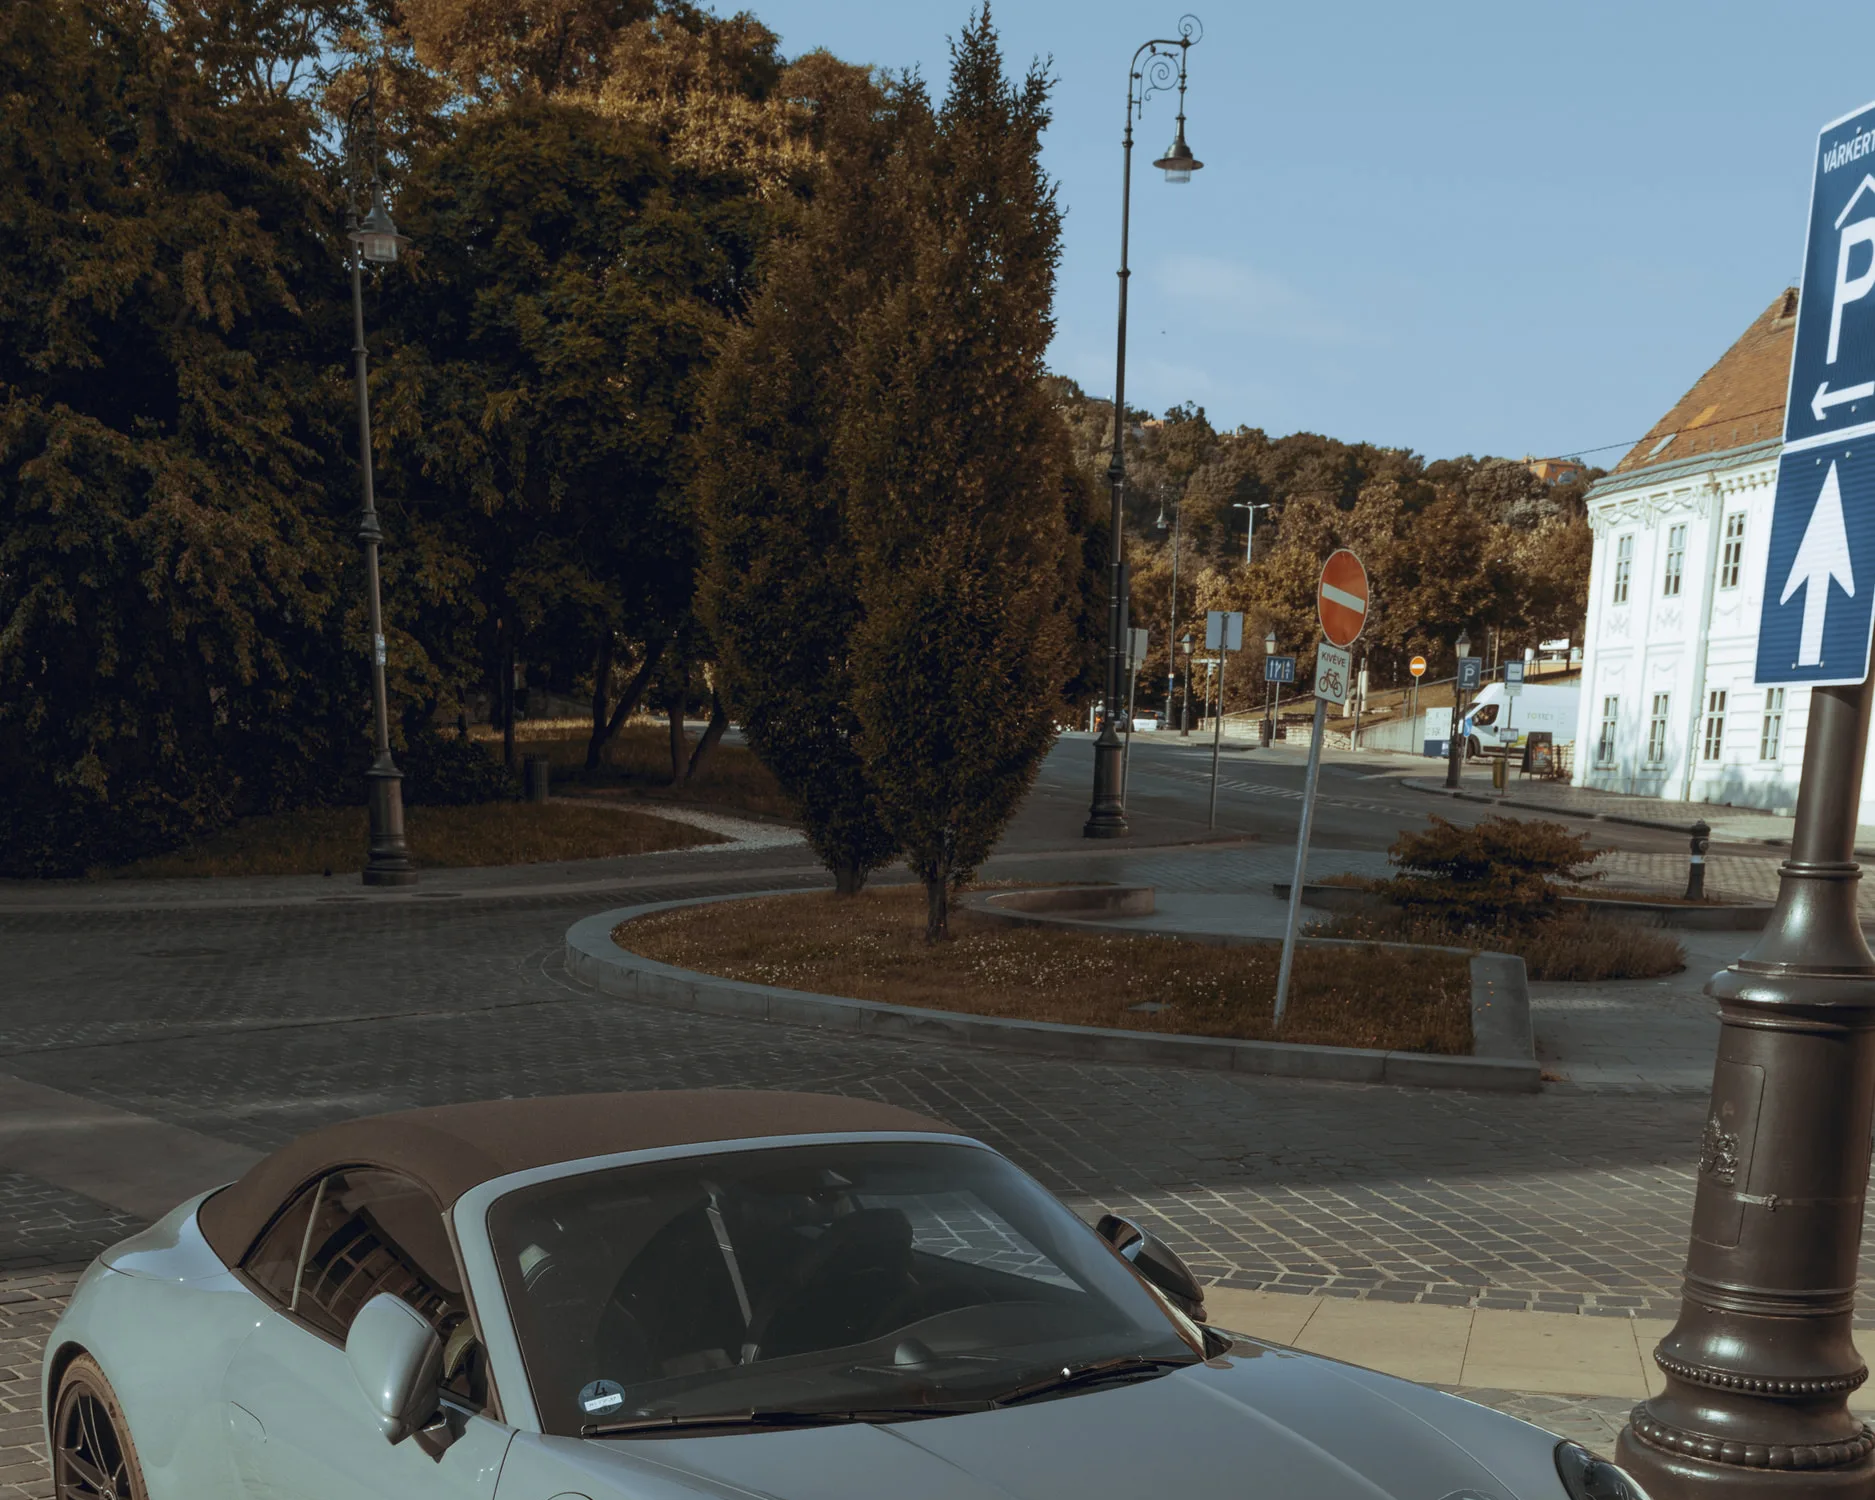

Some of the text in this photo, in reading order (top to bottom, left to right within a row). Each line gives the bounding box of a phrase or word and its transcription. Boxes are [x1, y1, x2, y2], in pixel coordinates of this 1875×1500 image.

[1826, 217, 1875, 365] P
[1321, 651, 1346, 668] KIVÉVE
[1464, 667, 1475, 682] P
[594, 1381, 608, 1397] 4
